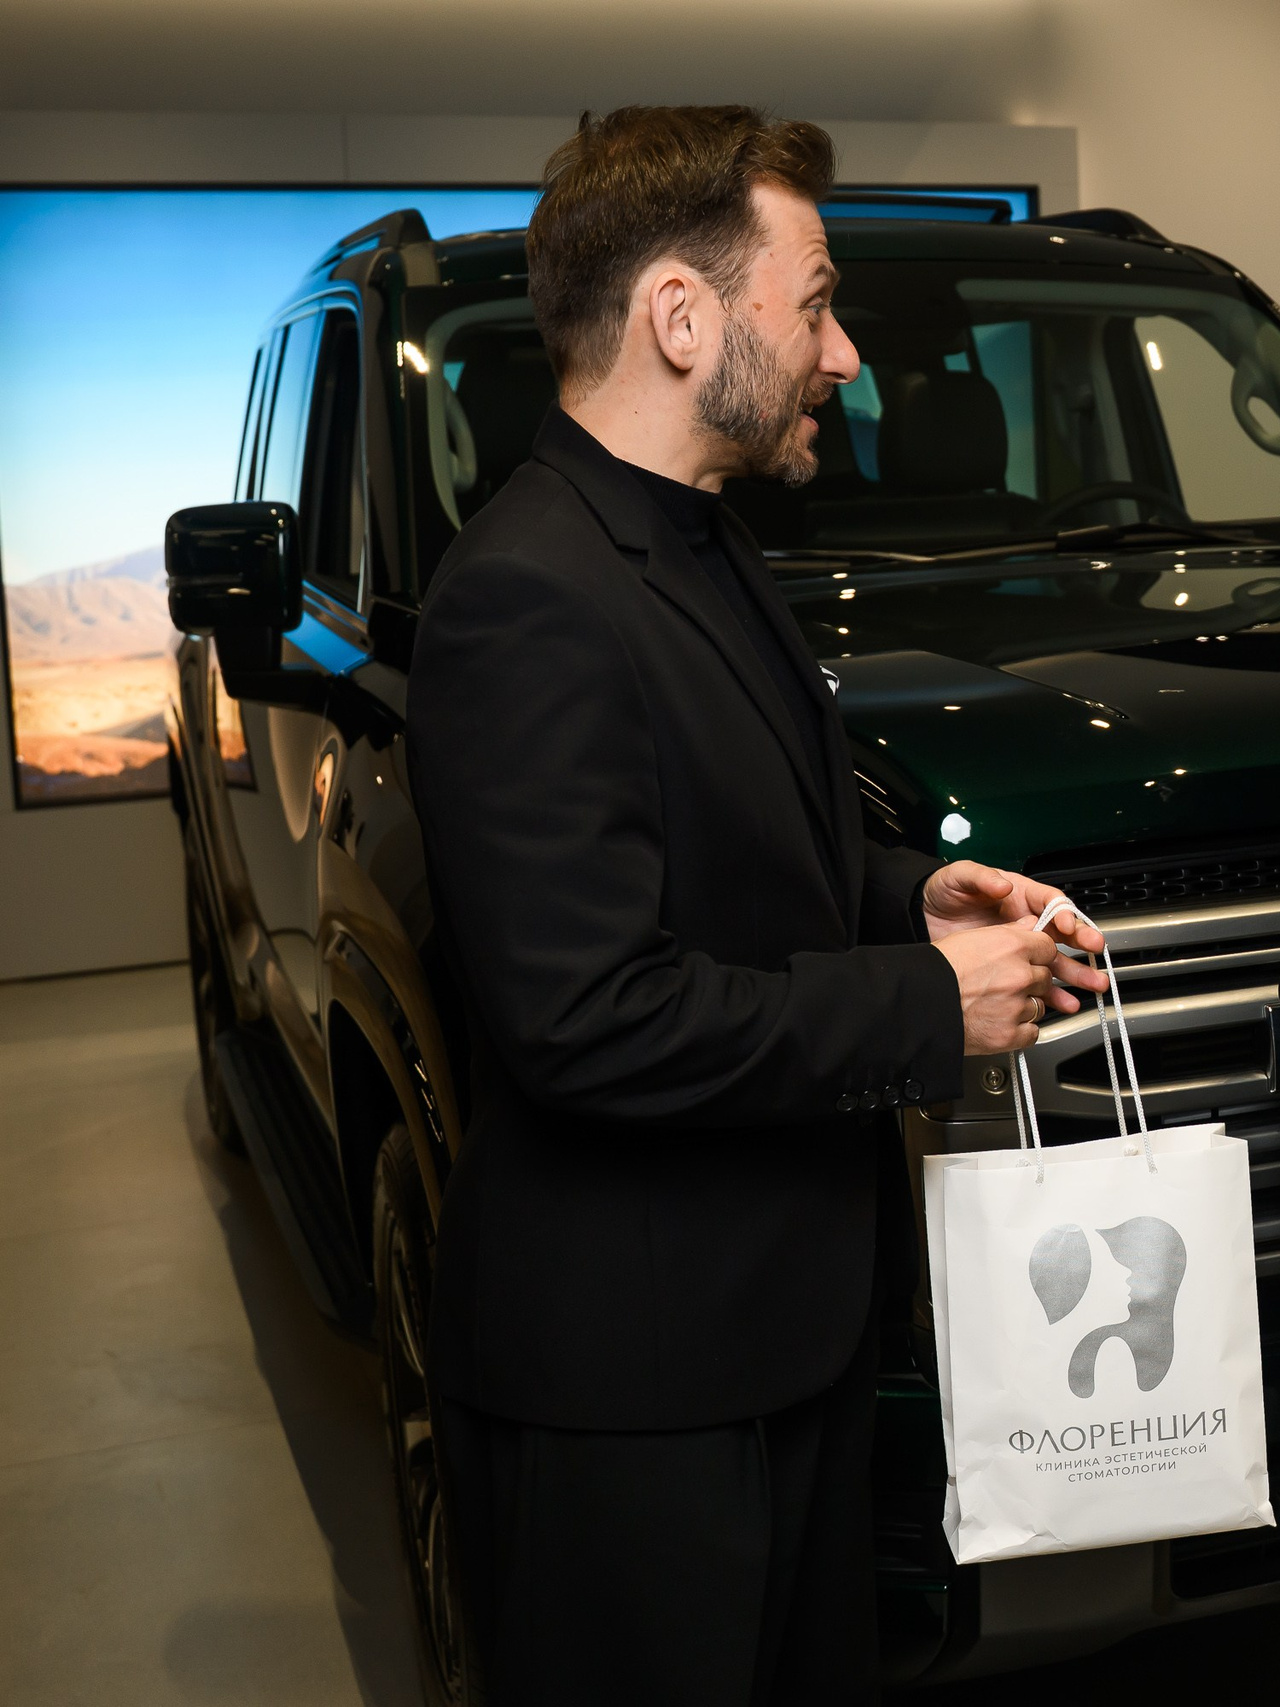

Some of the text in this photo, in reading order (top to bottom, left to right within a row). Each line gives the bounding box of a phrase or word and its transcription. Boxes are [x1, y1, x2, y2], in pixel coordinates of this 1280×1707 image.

[1008, 1407, 1228, 1455] ФЛОРЕНЦИЯ
[1035, 1443, 1208, 1472] КЛИНИКА ЭСТЕТИЧЕСКОЙ
[1067, 1460, 1178, 1483] СТОМАТОЛОГИИ
